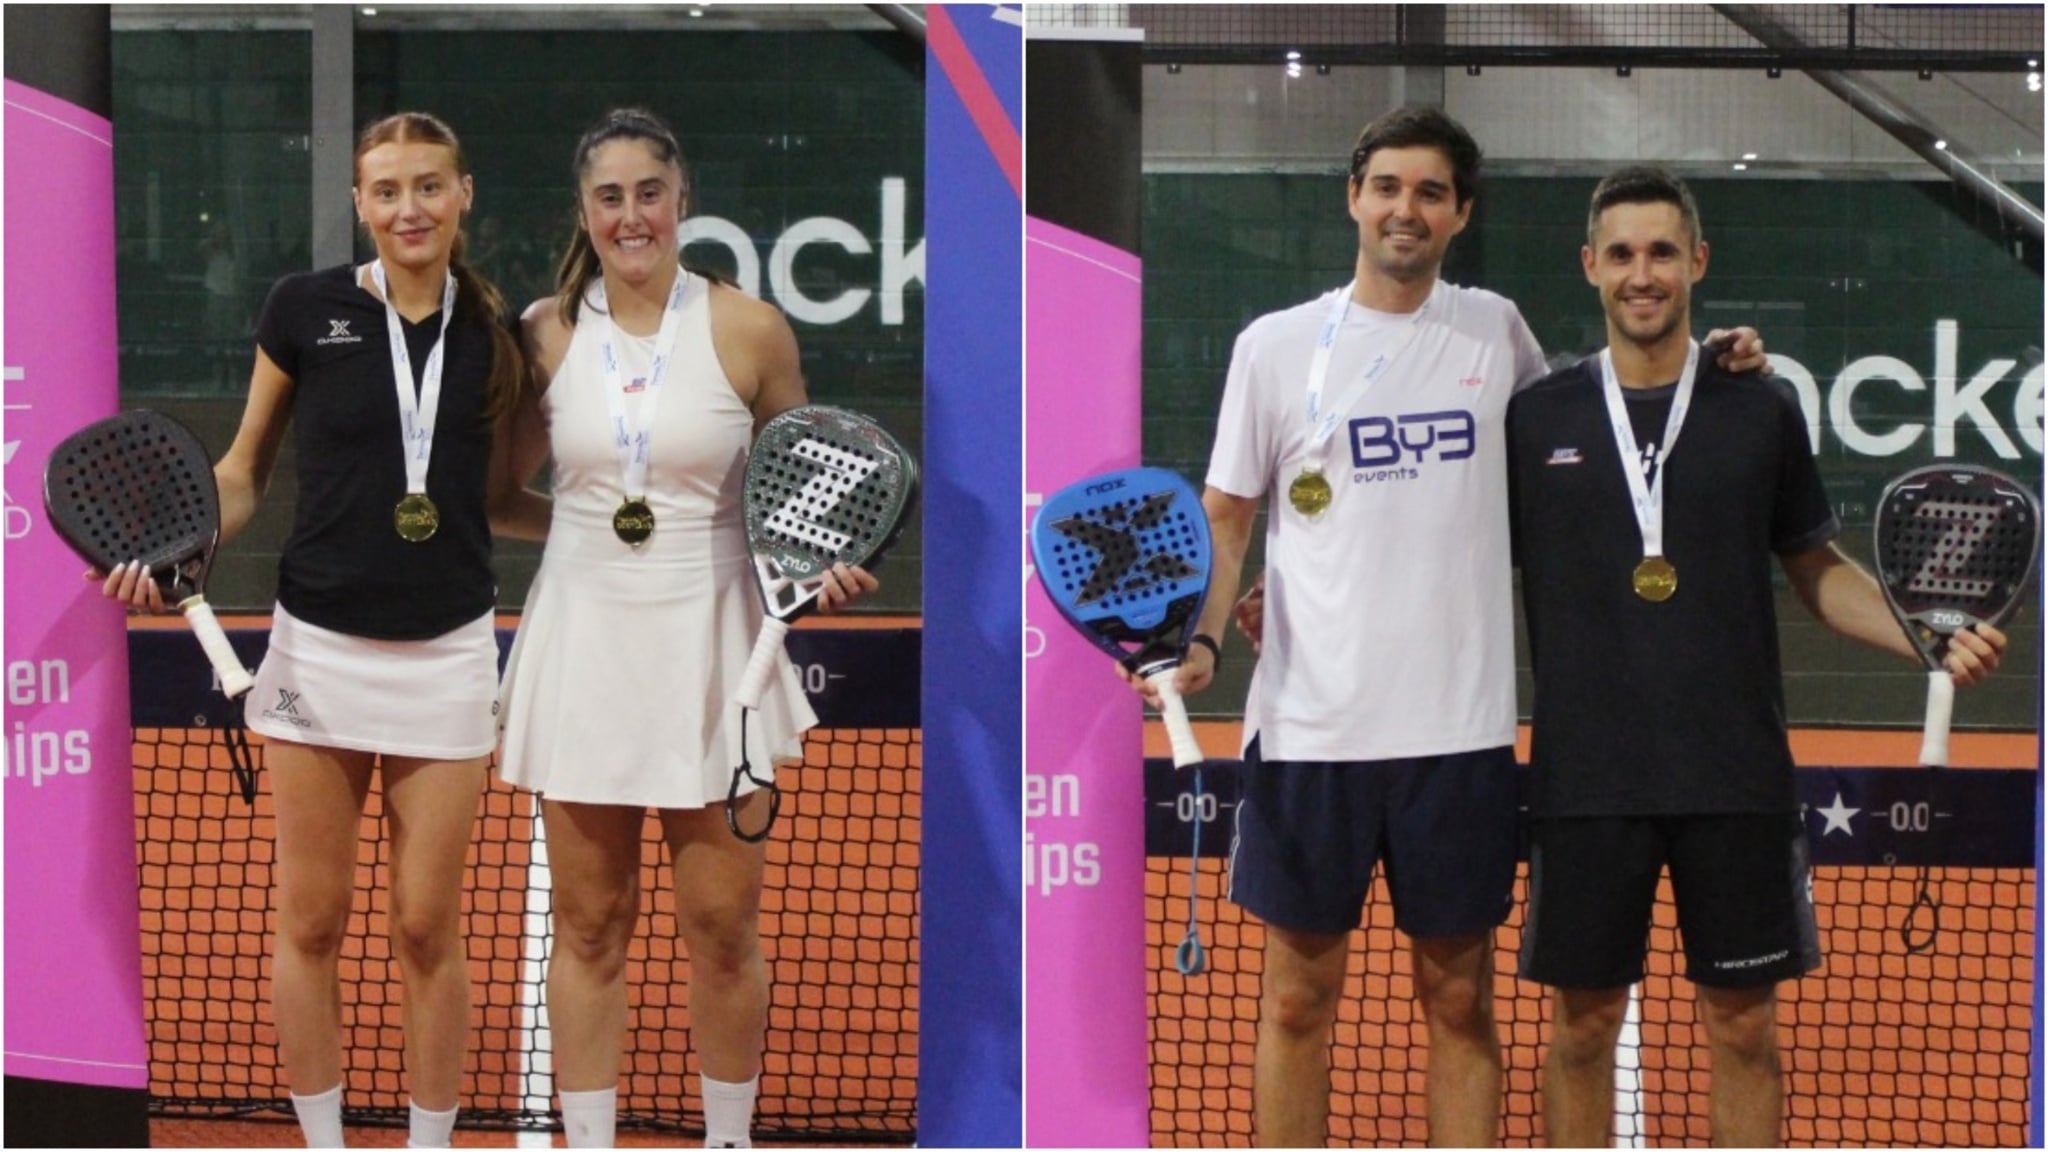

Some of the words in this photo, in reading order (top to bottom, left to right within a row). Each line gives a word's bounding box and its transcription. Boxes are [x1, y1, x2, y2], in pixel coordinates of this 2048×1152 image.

[1353, 467, 1419, 483] events
[1085, 477, 1127, 496] nox
[780, 554, 812, 573] ZYLO
[1932, 612, 1965, 626] ZYLO
[8, 658, 70, 706] en
[4, 720, 92, 788] ips
[1890, 801, 1929, 832] 0.0
